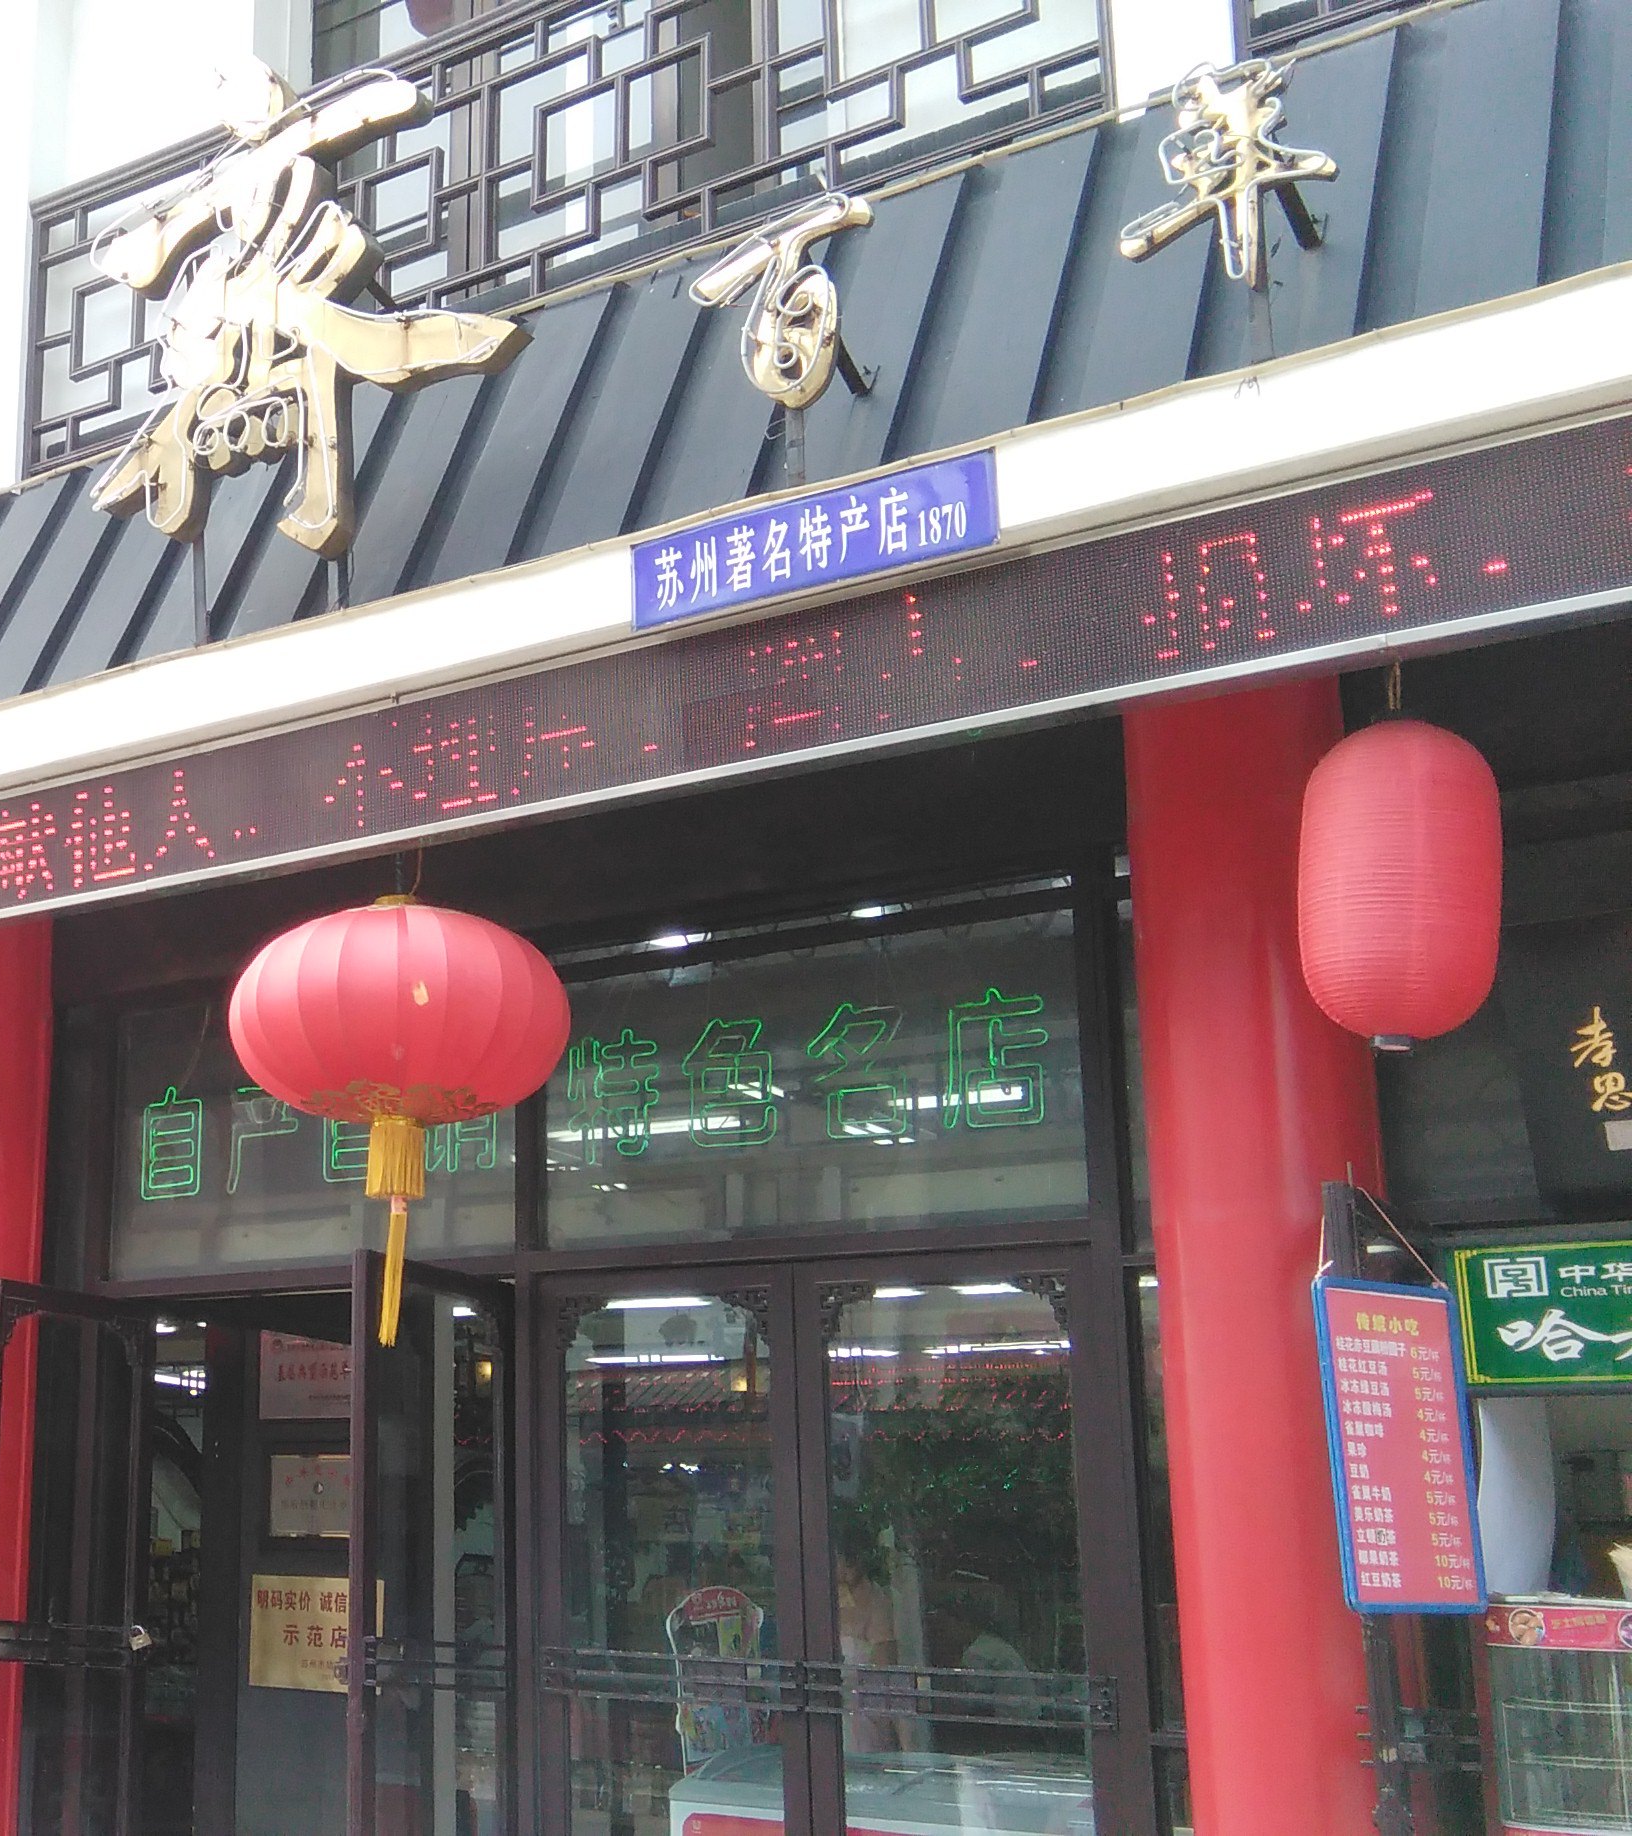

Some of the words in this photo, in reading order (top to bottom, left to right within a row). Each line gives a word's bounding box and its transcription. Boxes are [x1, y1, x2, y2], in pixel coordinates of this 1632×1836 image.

[654, 485, 909, 611] 苏州著名特产店
[917, 501, 968, 549] 1870
[565, 986, 1050, 1167] 特色名店
[1560, 1286, 1608, 1298] China
[1496, 1308, 1632, 1363] 哈
[257, 1589, 311, 1612] 明码实价
[319, 1591, 348, 1614] 诚信
[282, 1624, 348, 1649] 示范店
